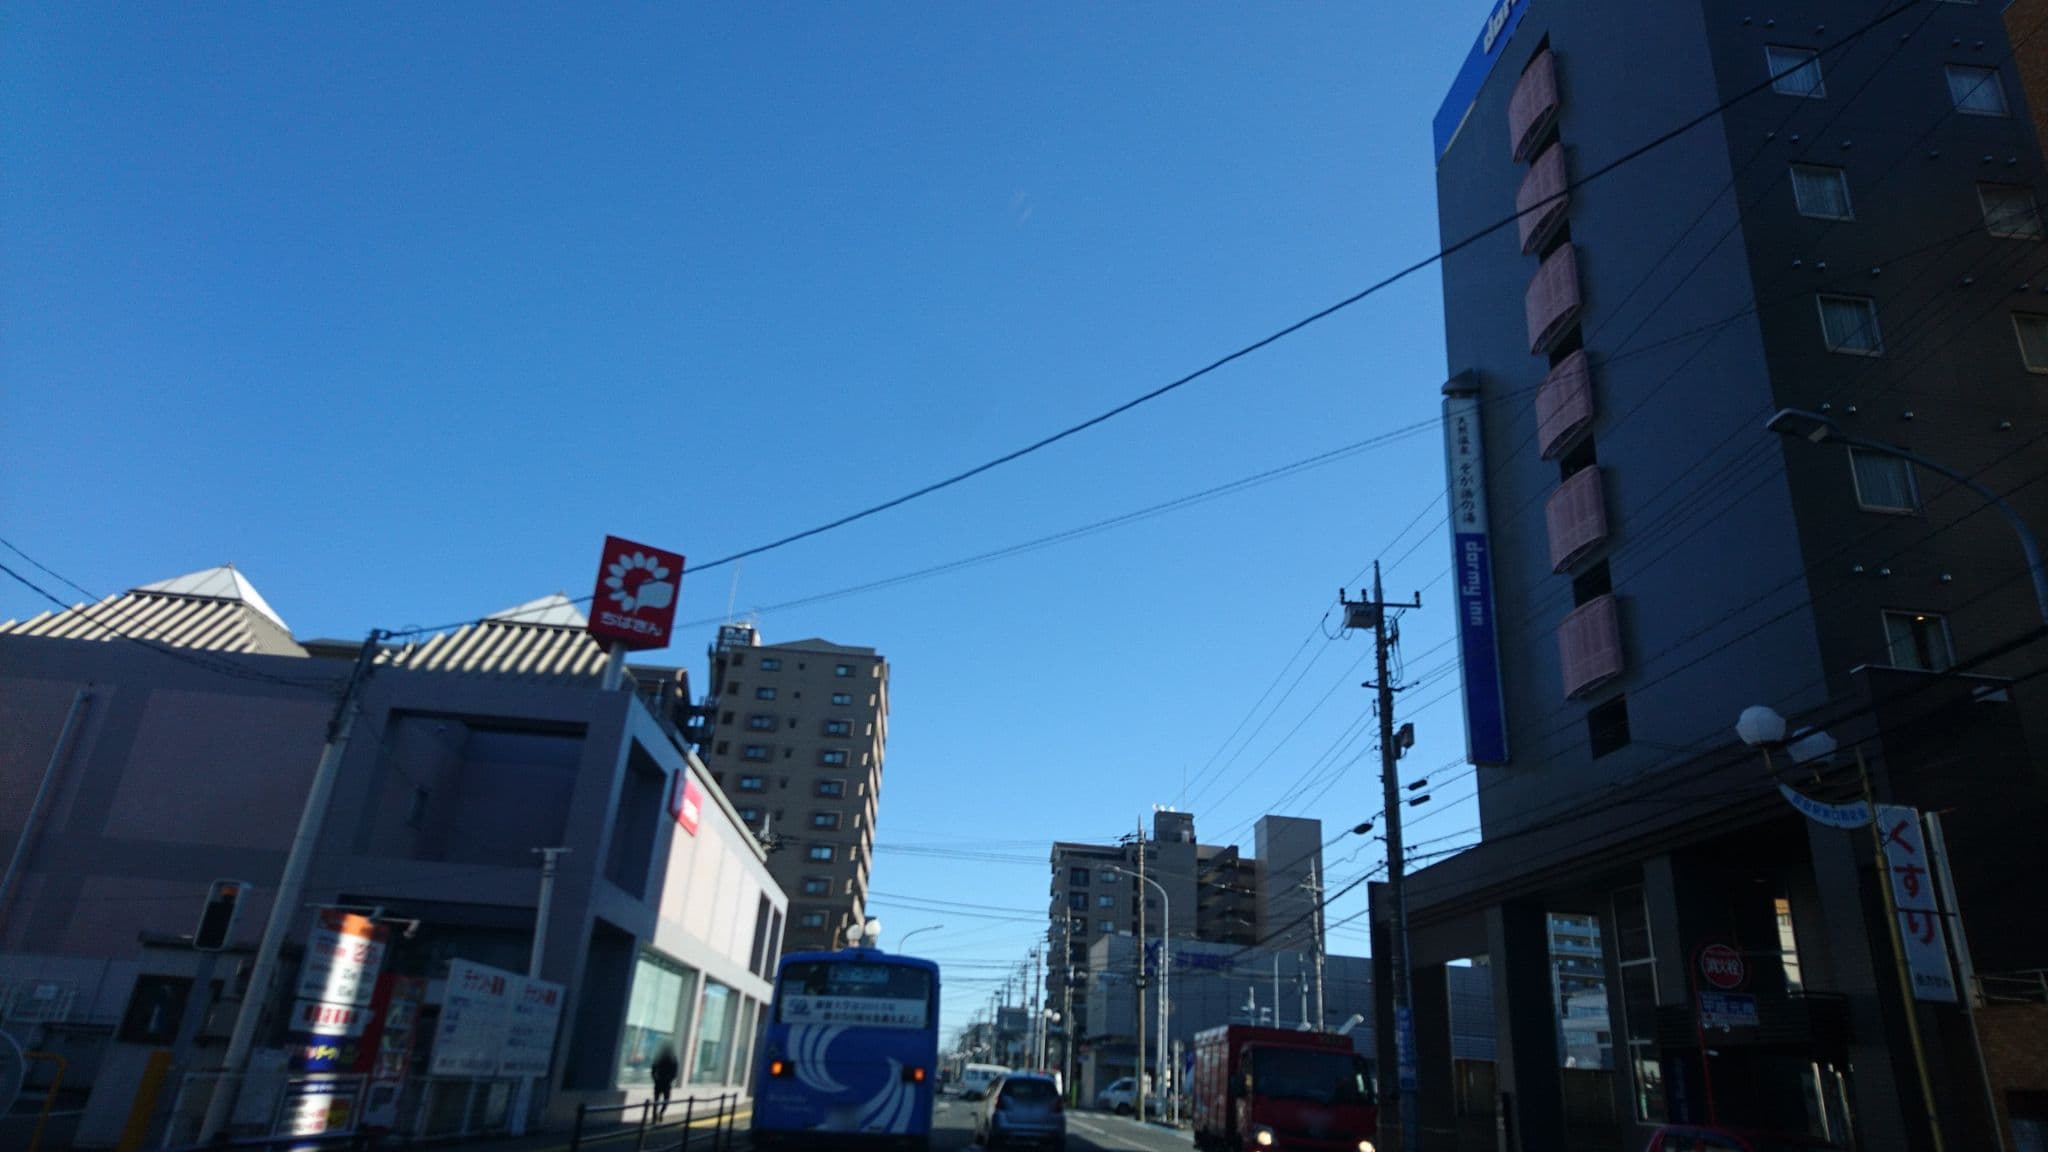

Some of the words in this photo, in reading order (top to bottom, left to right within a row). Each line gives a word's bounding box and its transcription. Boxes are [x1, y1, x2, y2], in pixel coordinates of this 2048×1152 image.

[1484, 0, 1520, 54] dor
[1463, 540, 1485, 597] dormy
[600, 611, 662, 637] ちばぎん
[1469, 600, 1484, 627] inn
[1890, 821, 1934, 944] くすり
